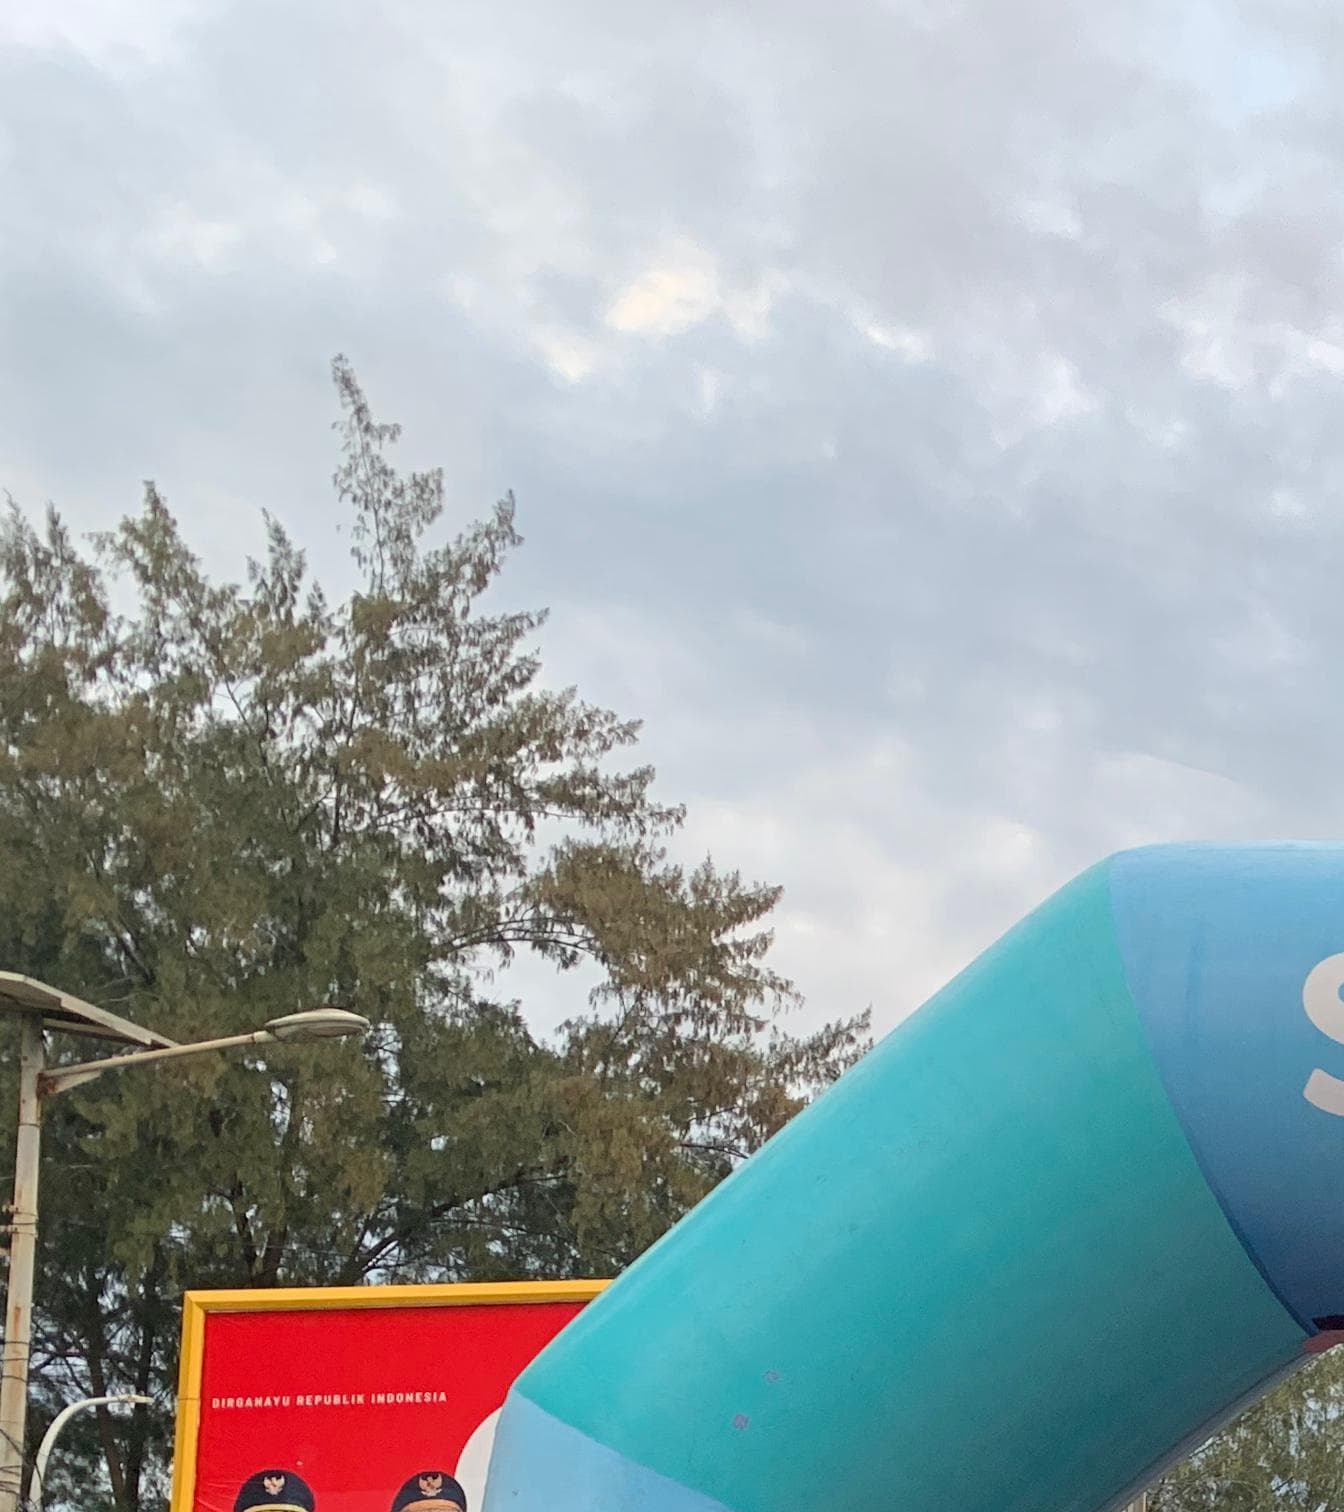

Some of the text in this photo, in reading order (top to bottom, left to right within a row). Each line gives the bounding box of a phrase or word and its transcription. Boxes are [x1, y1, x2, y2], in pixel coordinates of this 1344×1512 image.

[212, 1392, 447, 1409] DIRGAHAYU REPUBLIK INDONESIA
